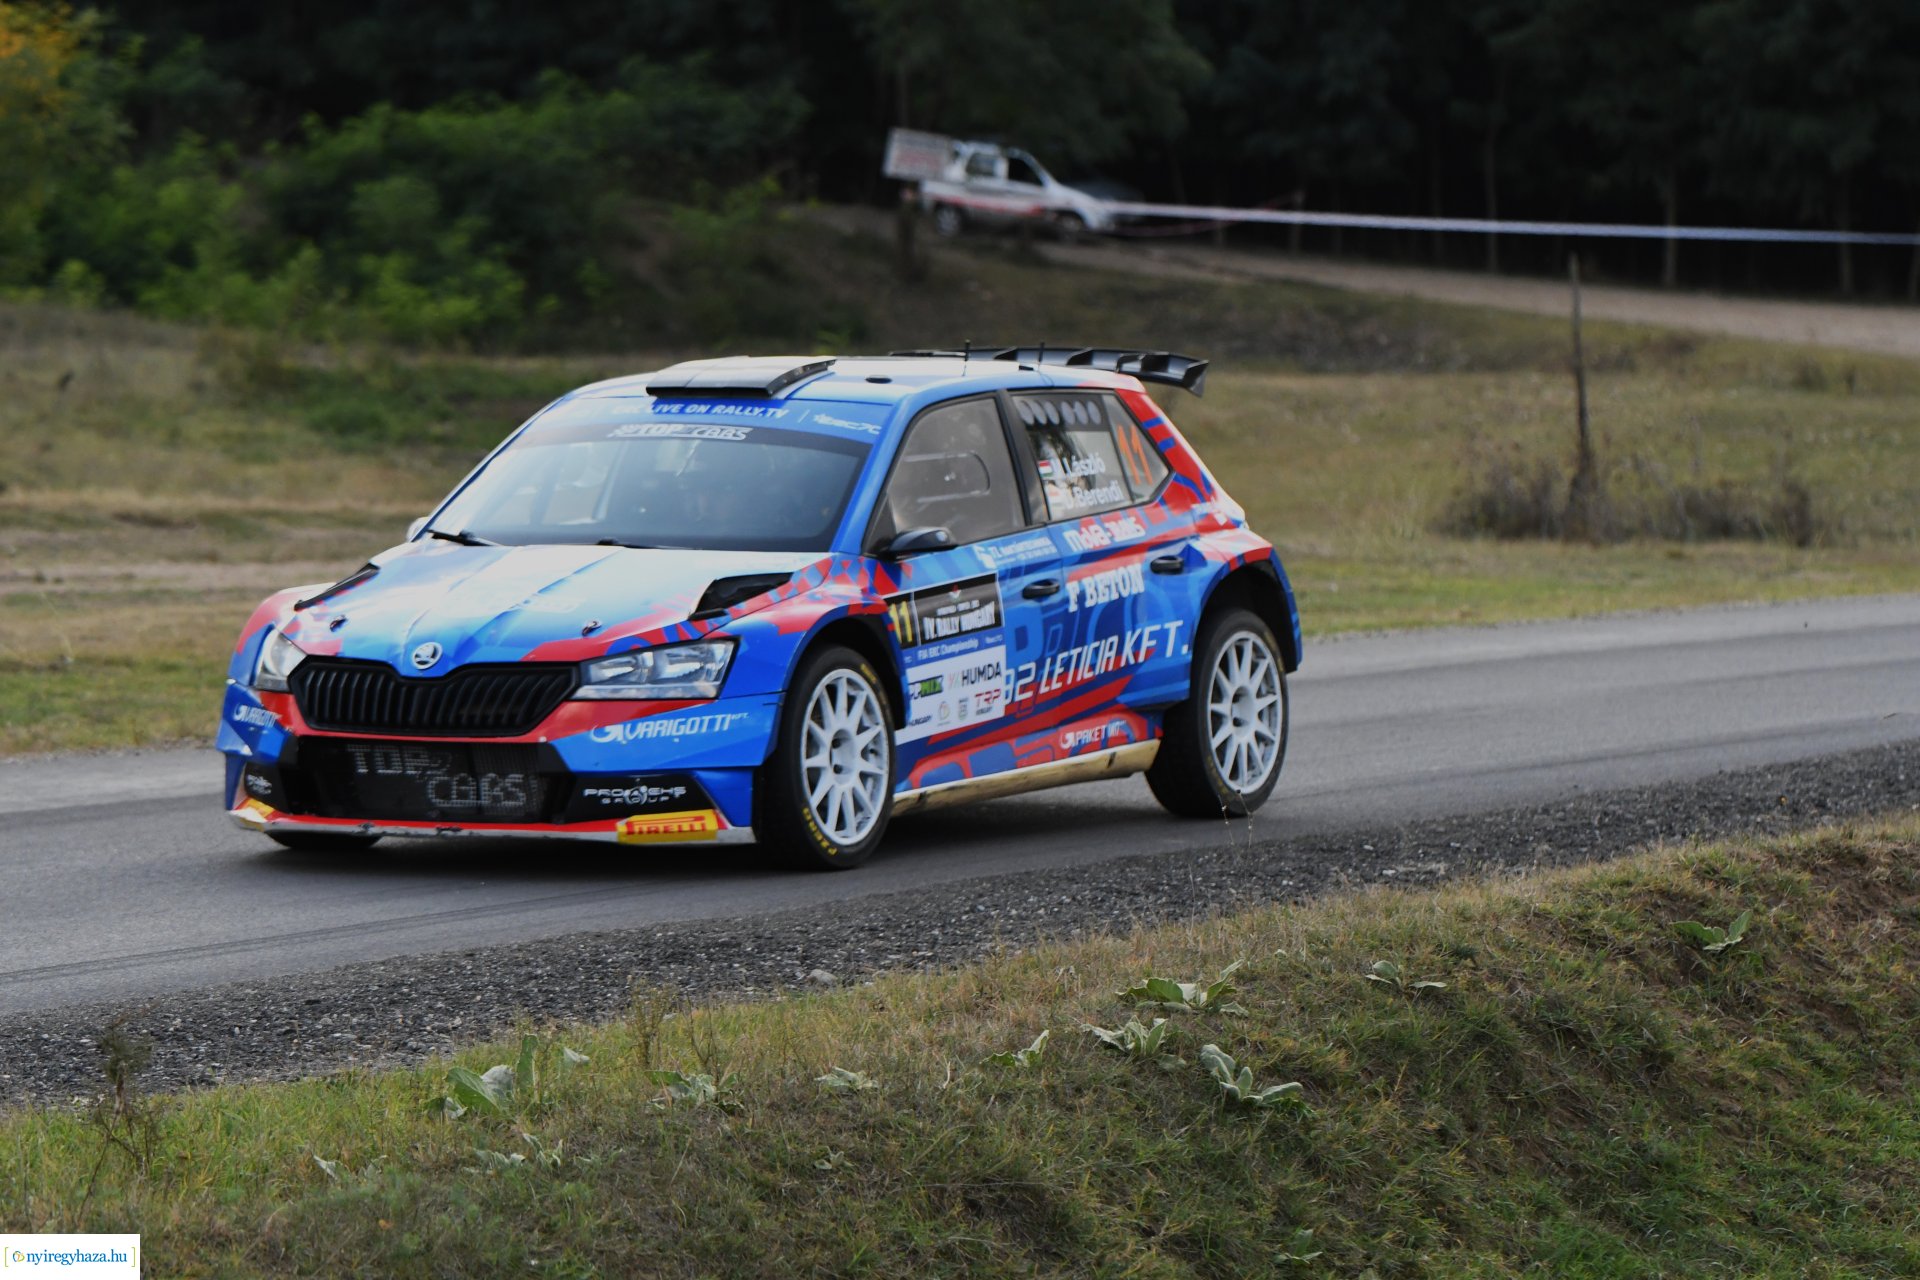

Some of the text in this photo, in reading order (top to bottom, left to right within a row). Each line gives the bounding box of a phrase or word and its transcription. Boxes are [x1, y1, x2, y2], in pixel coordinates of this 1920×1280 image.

[647, 403, 684, 414] LIVE
[685, 404, 711, 414] ON
[711, 404, 789, 419] RALLY.TV
[1082, 563, 1145, 608] BETON
[889, 600, 913, 643] 11
[961, 662, 1002, 687] HUMDA
[1040, 635, 1119, 694] LETICIA
[625, 714, 732, 741] VARIGOTTI
[427, 773, 527, 808] CARS
[626, 815, 706, 836] PIRELLI
